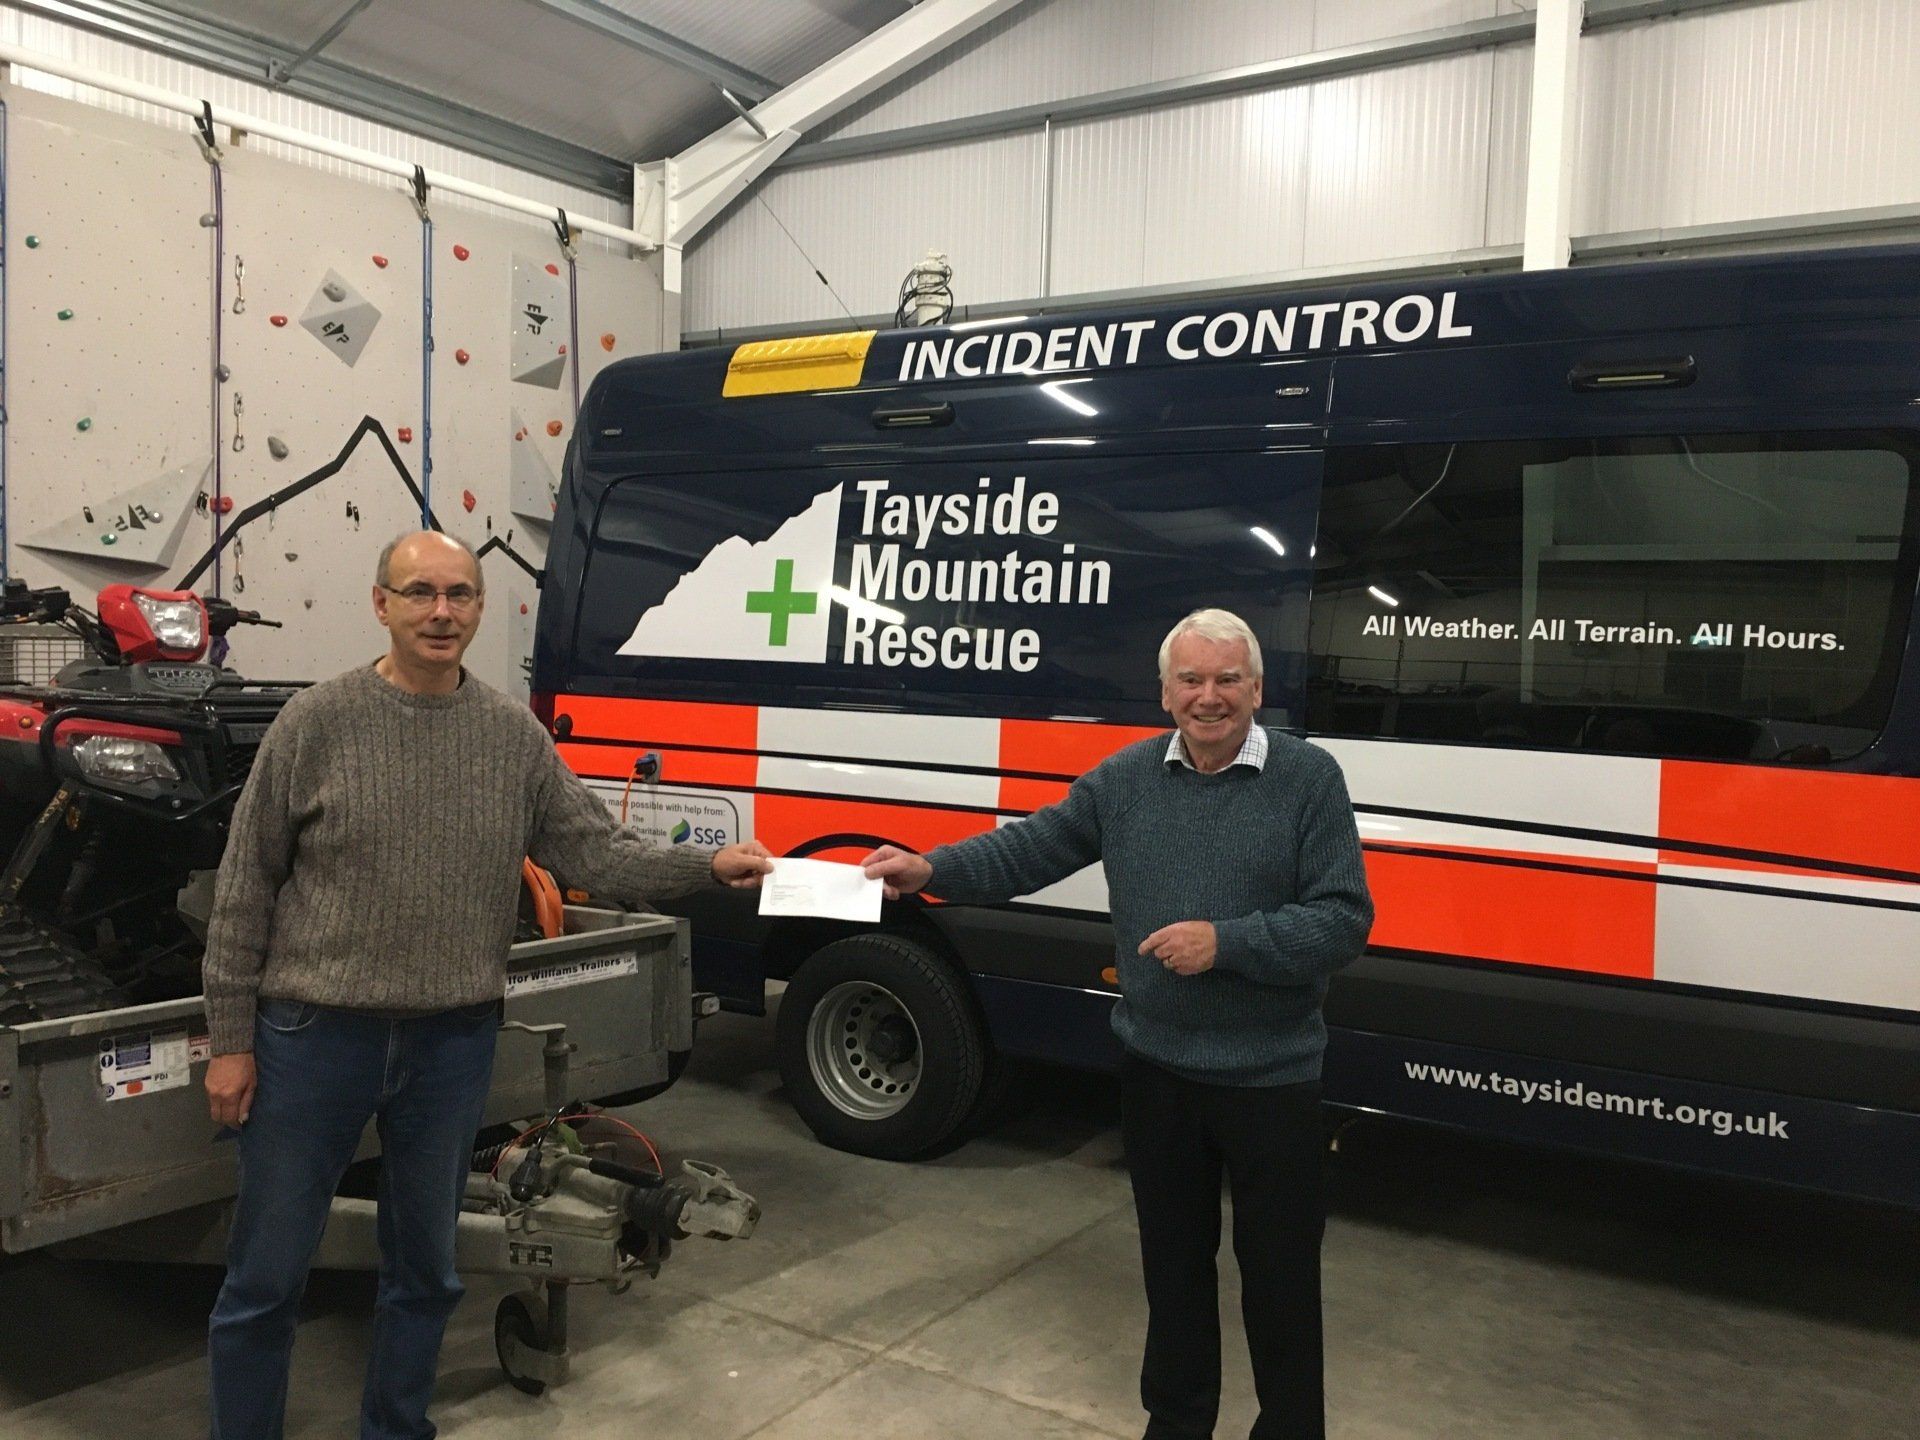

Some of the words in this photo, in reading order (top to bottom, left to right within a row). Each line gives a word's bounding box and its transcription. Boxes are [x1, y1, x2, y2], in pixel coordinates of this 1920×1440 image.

[898, 319, 1156, 382] INCIDENT
[1166, 291, 1473, 360] CONTROL
[855, 476, 1059, 550] Tayside
[849, 544, 1112, 604] Mountain
[843, 615, 1040, 673] Rescue
[1361, 614, 1396, 637] All
[1403, 615, 1519, 640] Weather.
[1527, 618, 1566, 641] All
[1574, 619, 1682, 645] Terrain.
[1691, 622, 1733, 646] All
[1743, 624, 1845, 651] Hours.
[630, 800, 664, 811] possible
[665, 802, 682, 813] with
[684, 804, 702, 815] help
[631, 825, 667, 837] Charitable
[632, 814, 645, 823] The
[508, 974, 528, 985] Ifor
[531, 966, 578, 981] Williams
[579, 958, 621, 972] Trailers
[1404, 1061, 1789, 1140] www.taysidemrt.org.uk
